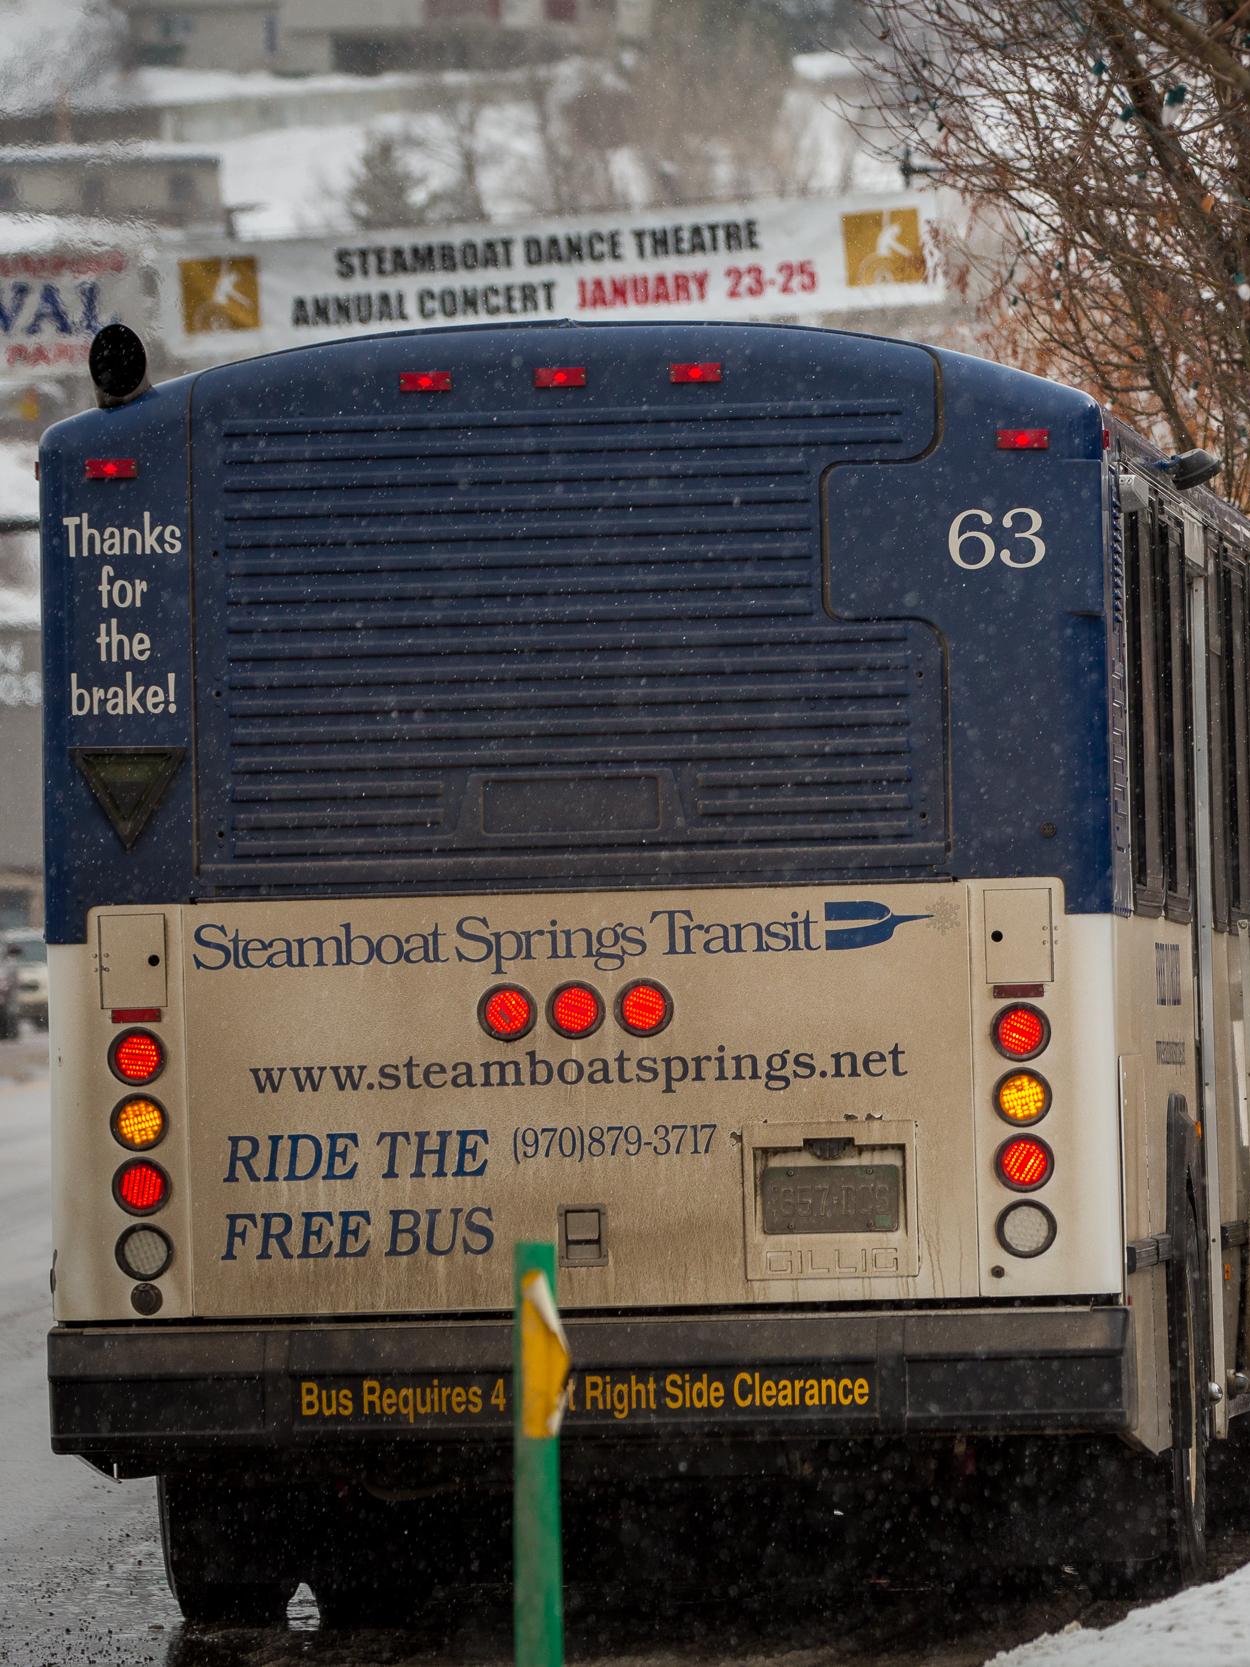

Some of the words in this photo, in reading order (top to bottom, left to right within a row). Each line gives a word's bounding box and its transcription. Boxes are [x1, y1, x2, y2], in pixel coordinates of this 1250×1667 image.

[334, 237, 514, 281] STEAMBOAT
[523, 228, 625, 269] DANCE
[632, 217, 761, 261] THEATRE
[291, 287, 409, 327] ANNUAL
[416, 278, 557, 321] CONCERT
[575, 270, 709, 311] JANUARY
[724, 259, 820, 300] 23-25
[62, 511, 182, 557] Thanks
[948, 507, 1046, 569] 63
[98, 565, 147, 608] for
[96, 618, 151, 662] the
[71, 671, 177, 716] brake!
[192, 922, 449, 971] Steamboat
[455, 915, 648, 975] Springs
[650, 909, 822, 956] Transit
[249, 1042, 908, 1095] www.steamboatsprings.net
[222, 1132, 360, 1184] RIDE
[375, 1129, 490, 1179] THE
[513, 1123, 718, 1165] (970)879-3717
[220, 1210, 372, 1261] FREE
[384, 1205, 495, 1257] BUS
[766, 1247, 899, 1275] GILLIG
[300, 1381, 353, 1417] Bus
[362, 1378, 483, 1423] Requires
[490, 1378, 507, 1412] 4
[584, 1374, 657, 1419] Right
[665, 1373, 725, 1409] Side
[733, 1371, 870, 1408] Clearance
